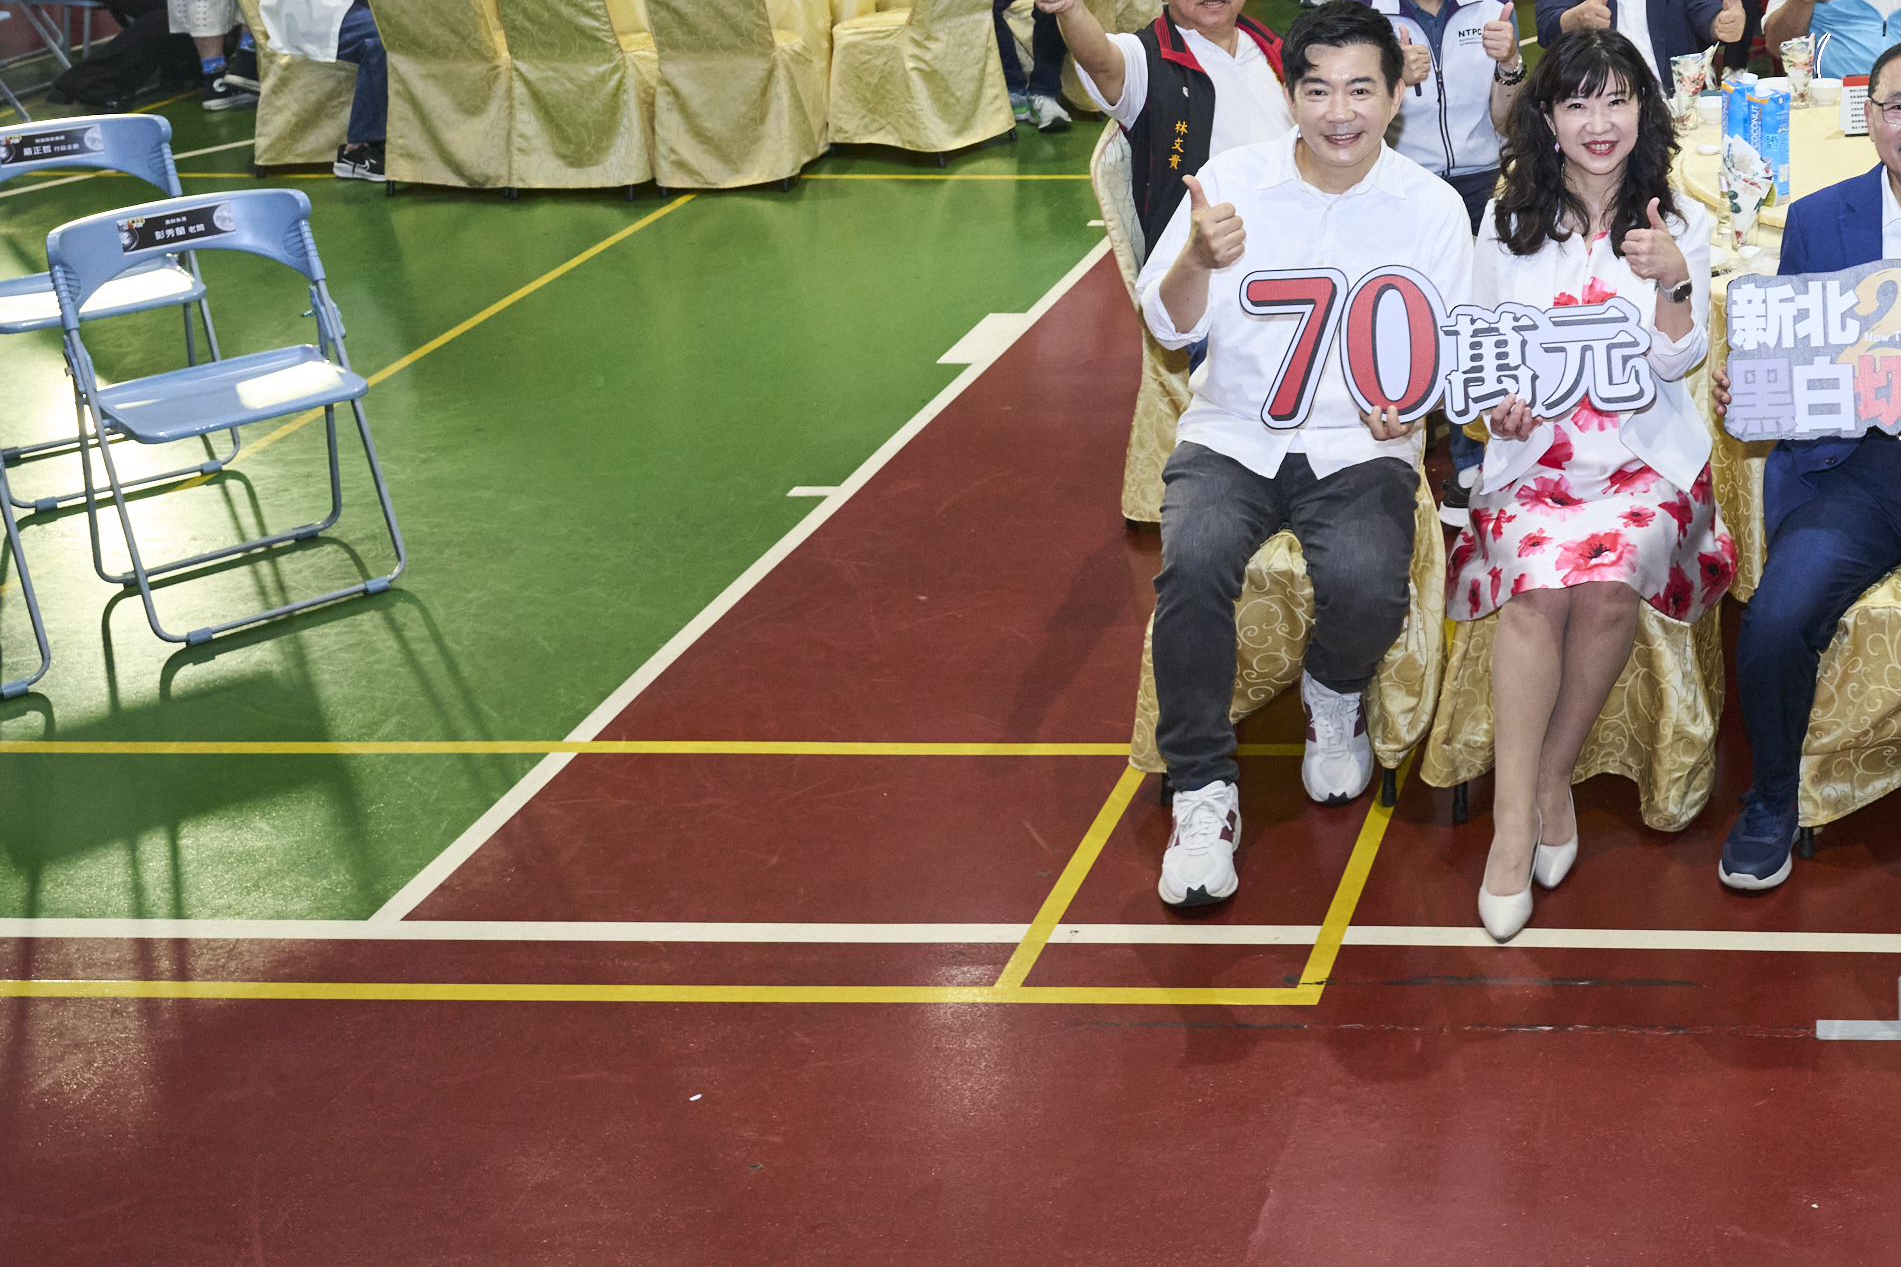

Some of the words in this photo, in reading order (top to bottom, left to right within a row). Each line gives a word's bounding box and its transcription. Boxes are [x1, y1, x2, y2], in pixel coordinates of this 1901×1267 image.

[1458, 28, 1482, 37] NTPC
[1751, 105, 1759, 149] COCONUT
[1168, 120, 1188, 170] 林文貴
[1864, 332, 1890, 342] New
